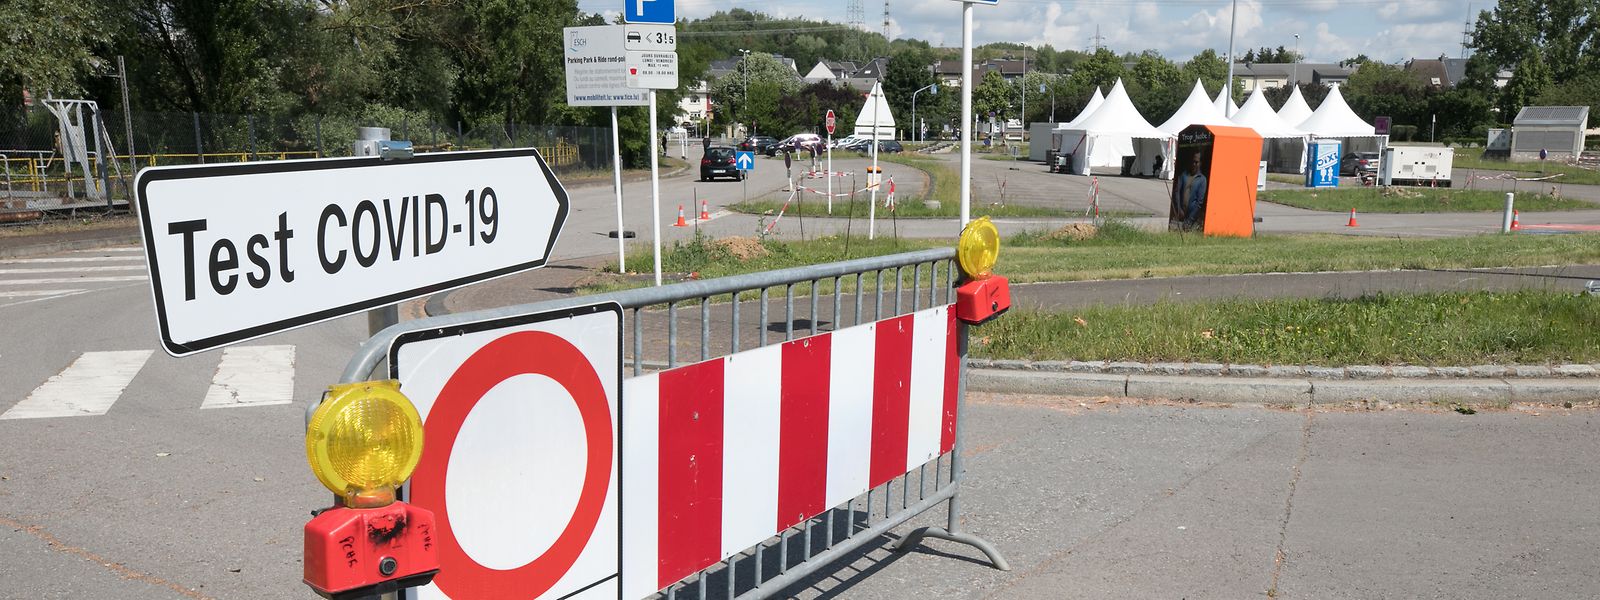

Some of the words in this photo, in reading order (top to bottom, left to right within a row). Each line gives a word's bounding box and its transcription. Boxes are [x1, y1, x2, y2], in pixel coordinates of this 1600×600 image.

[573, 38, 587, 46] ESCH
[168, 211, 295, 302] Test
[317, 186, 499, 275] COVID-19
